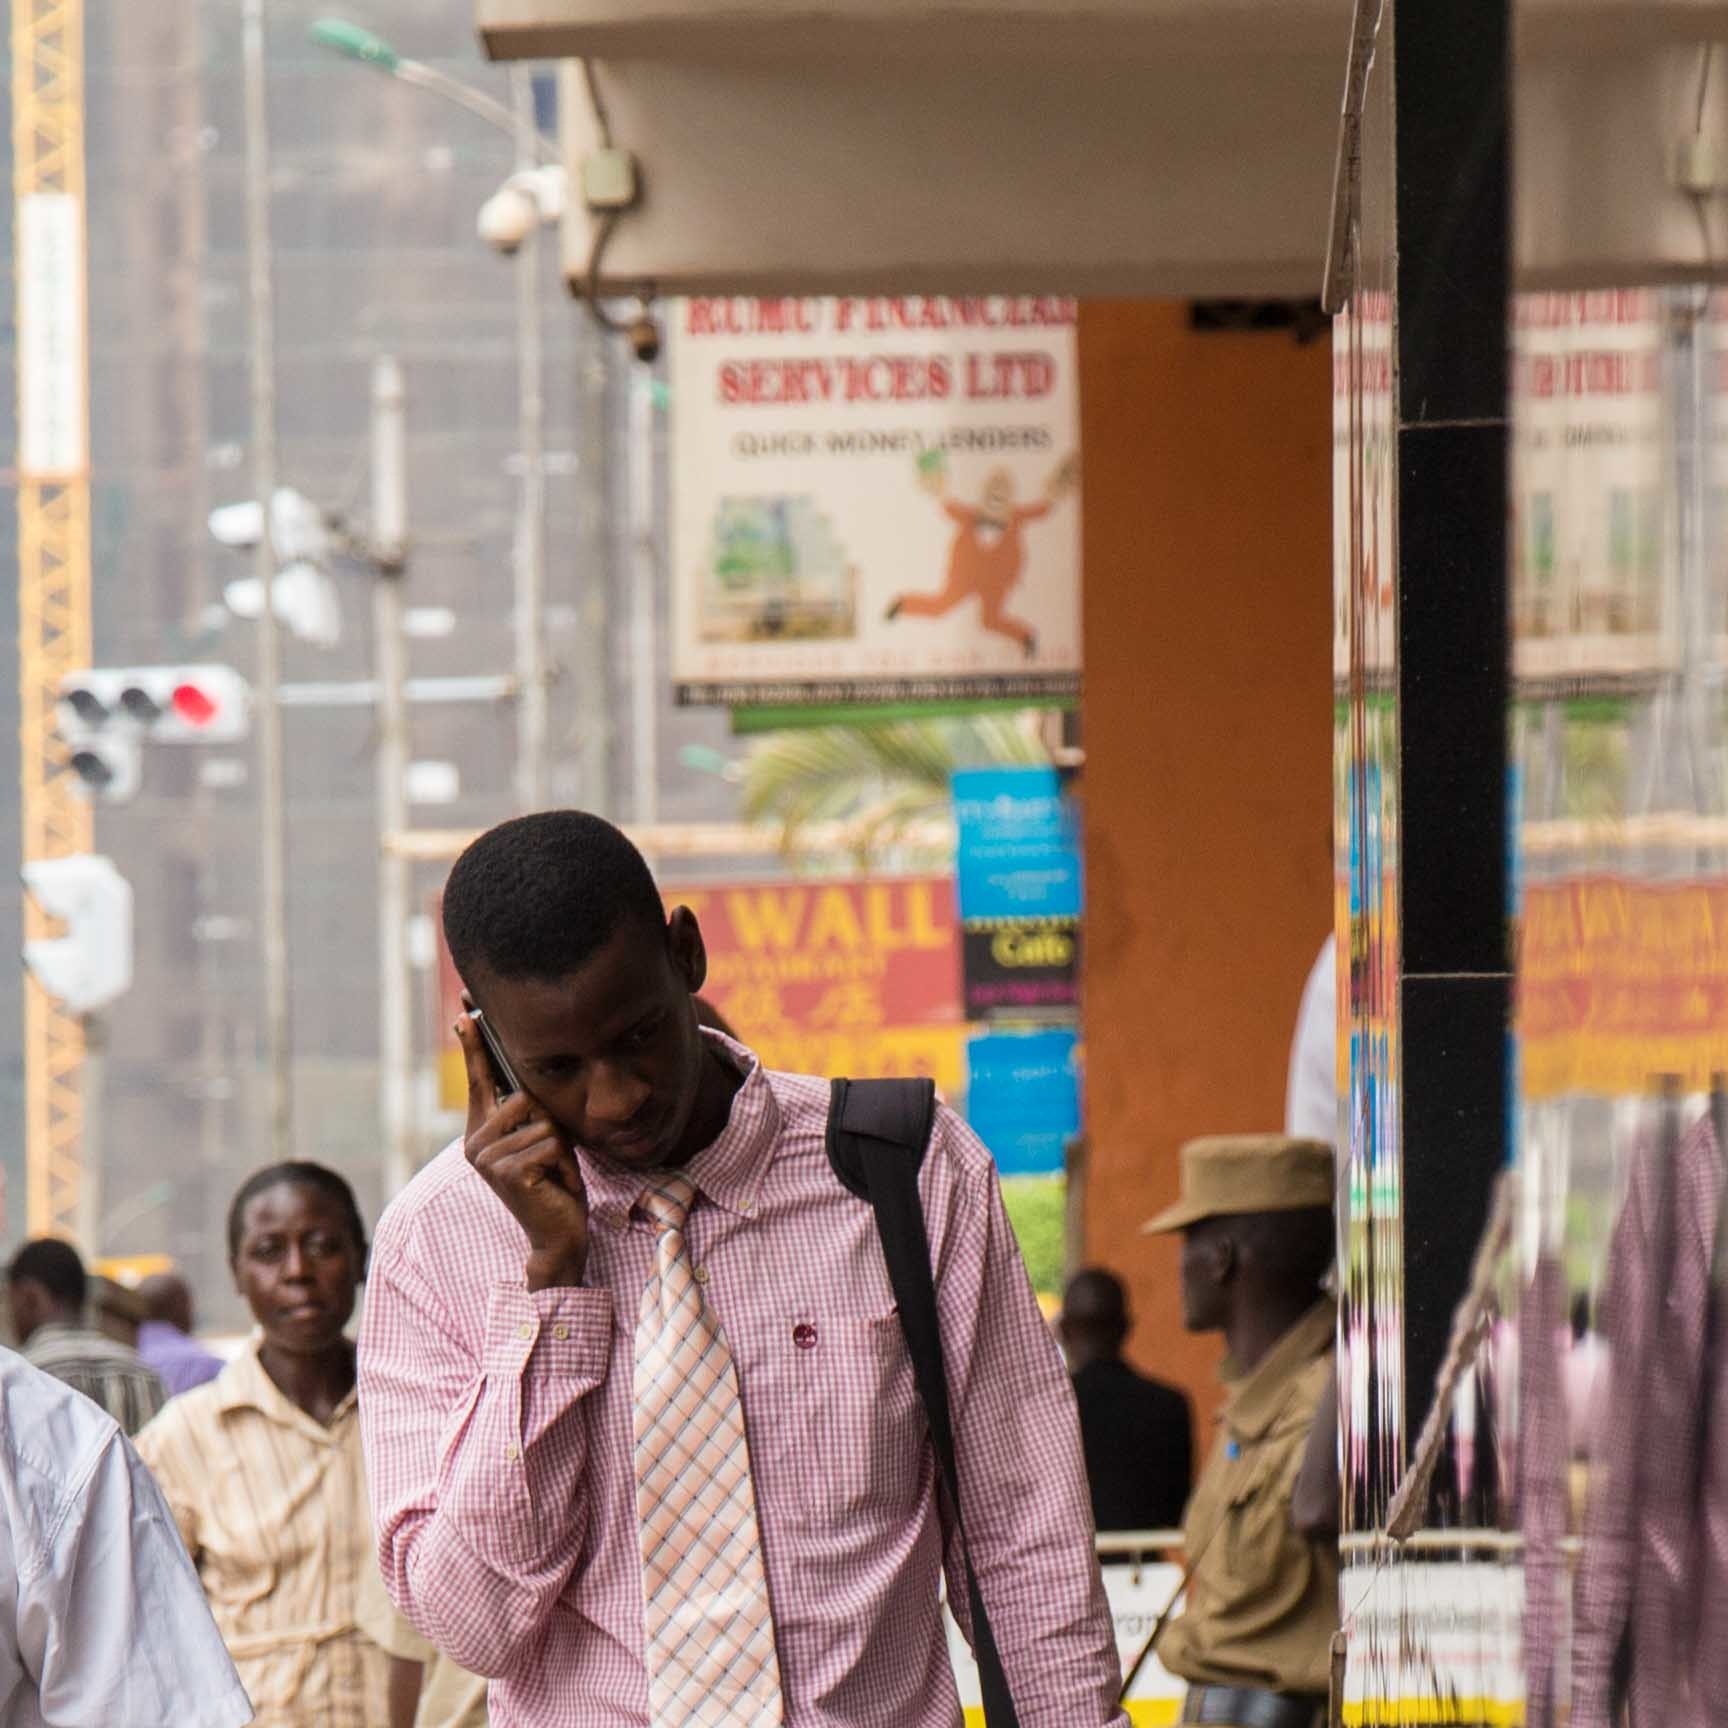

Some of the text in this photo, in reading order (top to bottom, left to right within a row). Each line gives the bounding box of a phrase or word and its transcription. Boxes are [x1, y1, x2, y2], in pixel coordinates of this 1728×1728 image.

[718, 350, 1056, 402] SERVICES LTD
[724, 882, 950, 951] WALL
